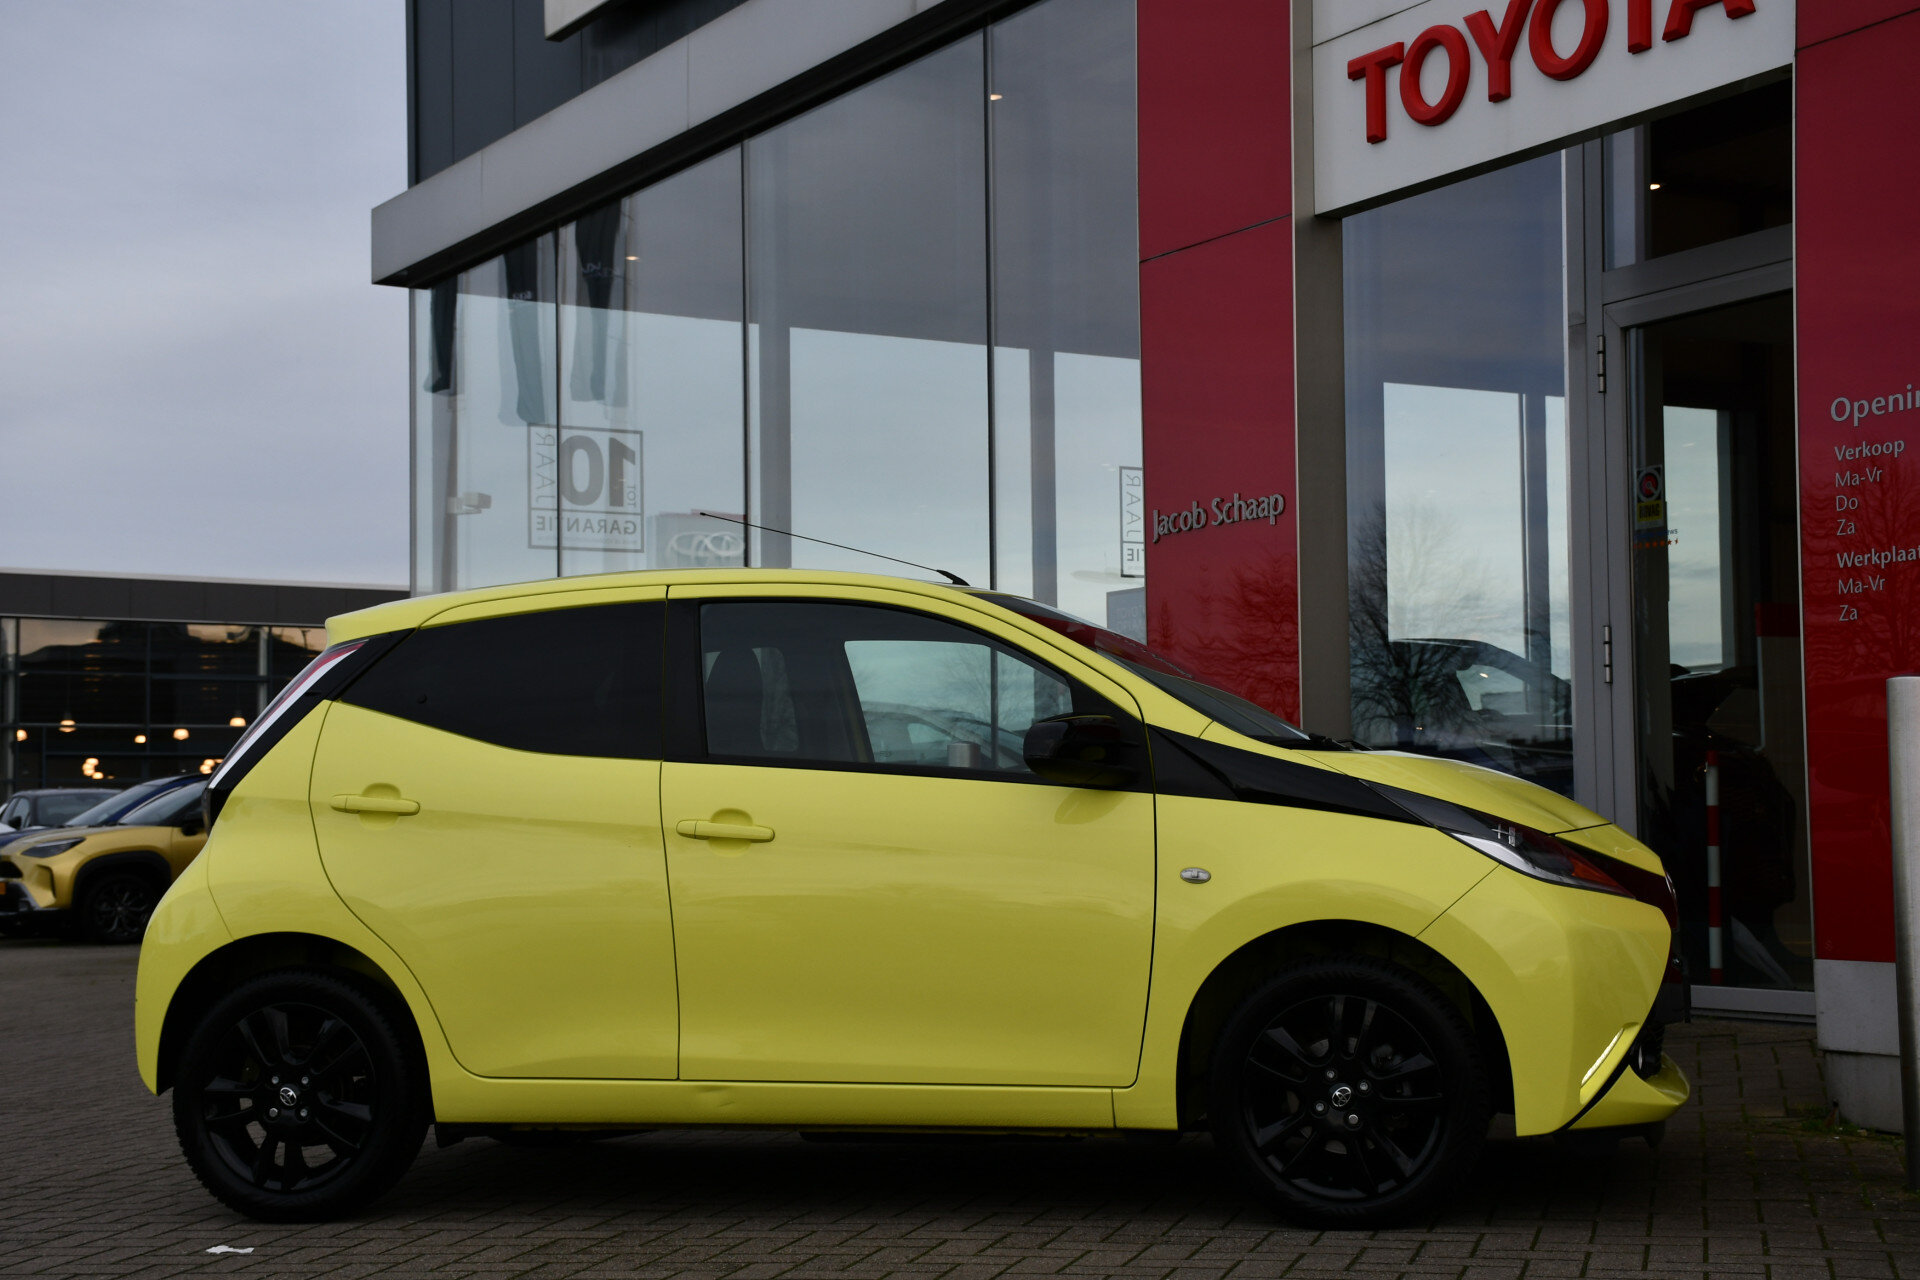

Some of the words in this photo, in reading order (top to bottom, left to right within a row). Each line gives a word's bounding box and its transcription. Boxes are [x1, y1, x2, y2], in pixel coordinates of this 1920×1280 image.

[1830, 384, 1920, 426] Openi
[1834, 439, 1905, 461] Verkoop
[1835, 466, 1883, 487] Ma-Vr
[1835, 495, 1859, 511] Do
[1152, 501, 1207, 543] Jacob
[1211, 493, 1285, 526] Schaap
[1836, 519, 1856, 535] Za
[1838, 575, 1886, 595] Ma-Vr
[1839, 605, 1858, 621] Za
